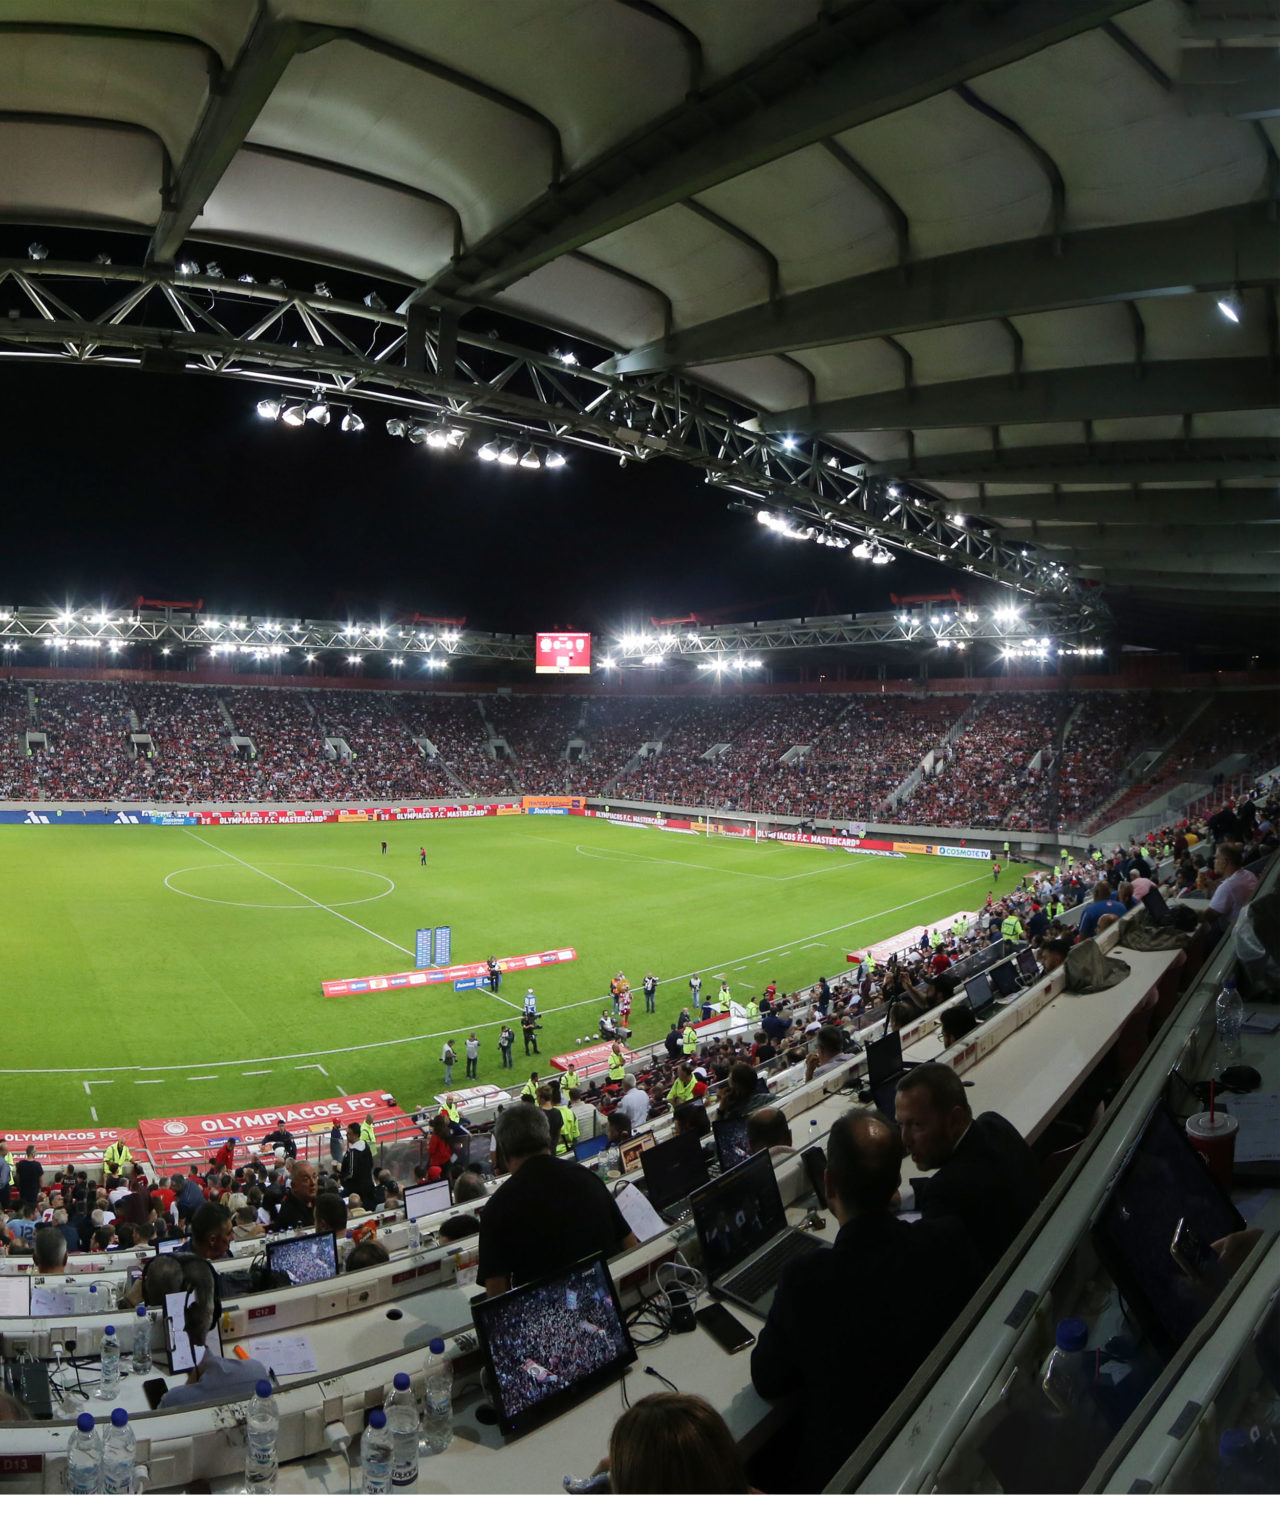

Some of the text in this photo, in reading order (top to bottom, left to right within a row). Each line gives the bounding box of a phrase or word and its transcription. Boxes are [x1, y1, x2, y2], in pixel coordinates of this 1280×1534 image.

[219, 817, 263, 825] OLYMPIACOS
[264, 816, 277, 824] F.C.
[396, 812, 434, 820] OLYMPIACOS
[797, 833, 810, 843] F.C.
[946, 847, 989, 858] COSMOTE TV
[201, 1097, 376, 1132] OLYMPIACOS FC
[4, 1130, 118, 1142] OLYMPIACOS FC
[20, 1225, 34, 1241] 12
[3, 1458, 29, 1471] D13
